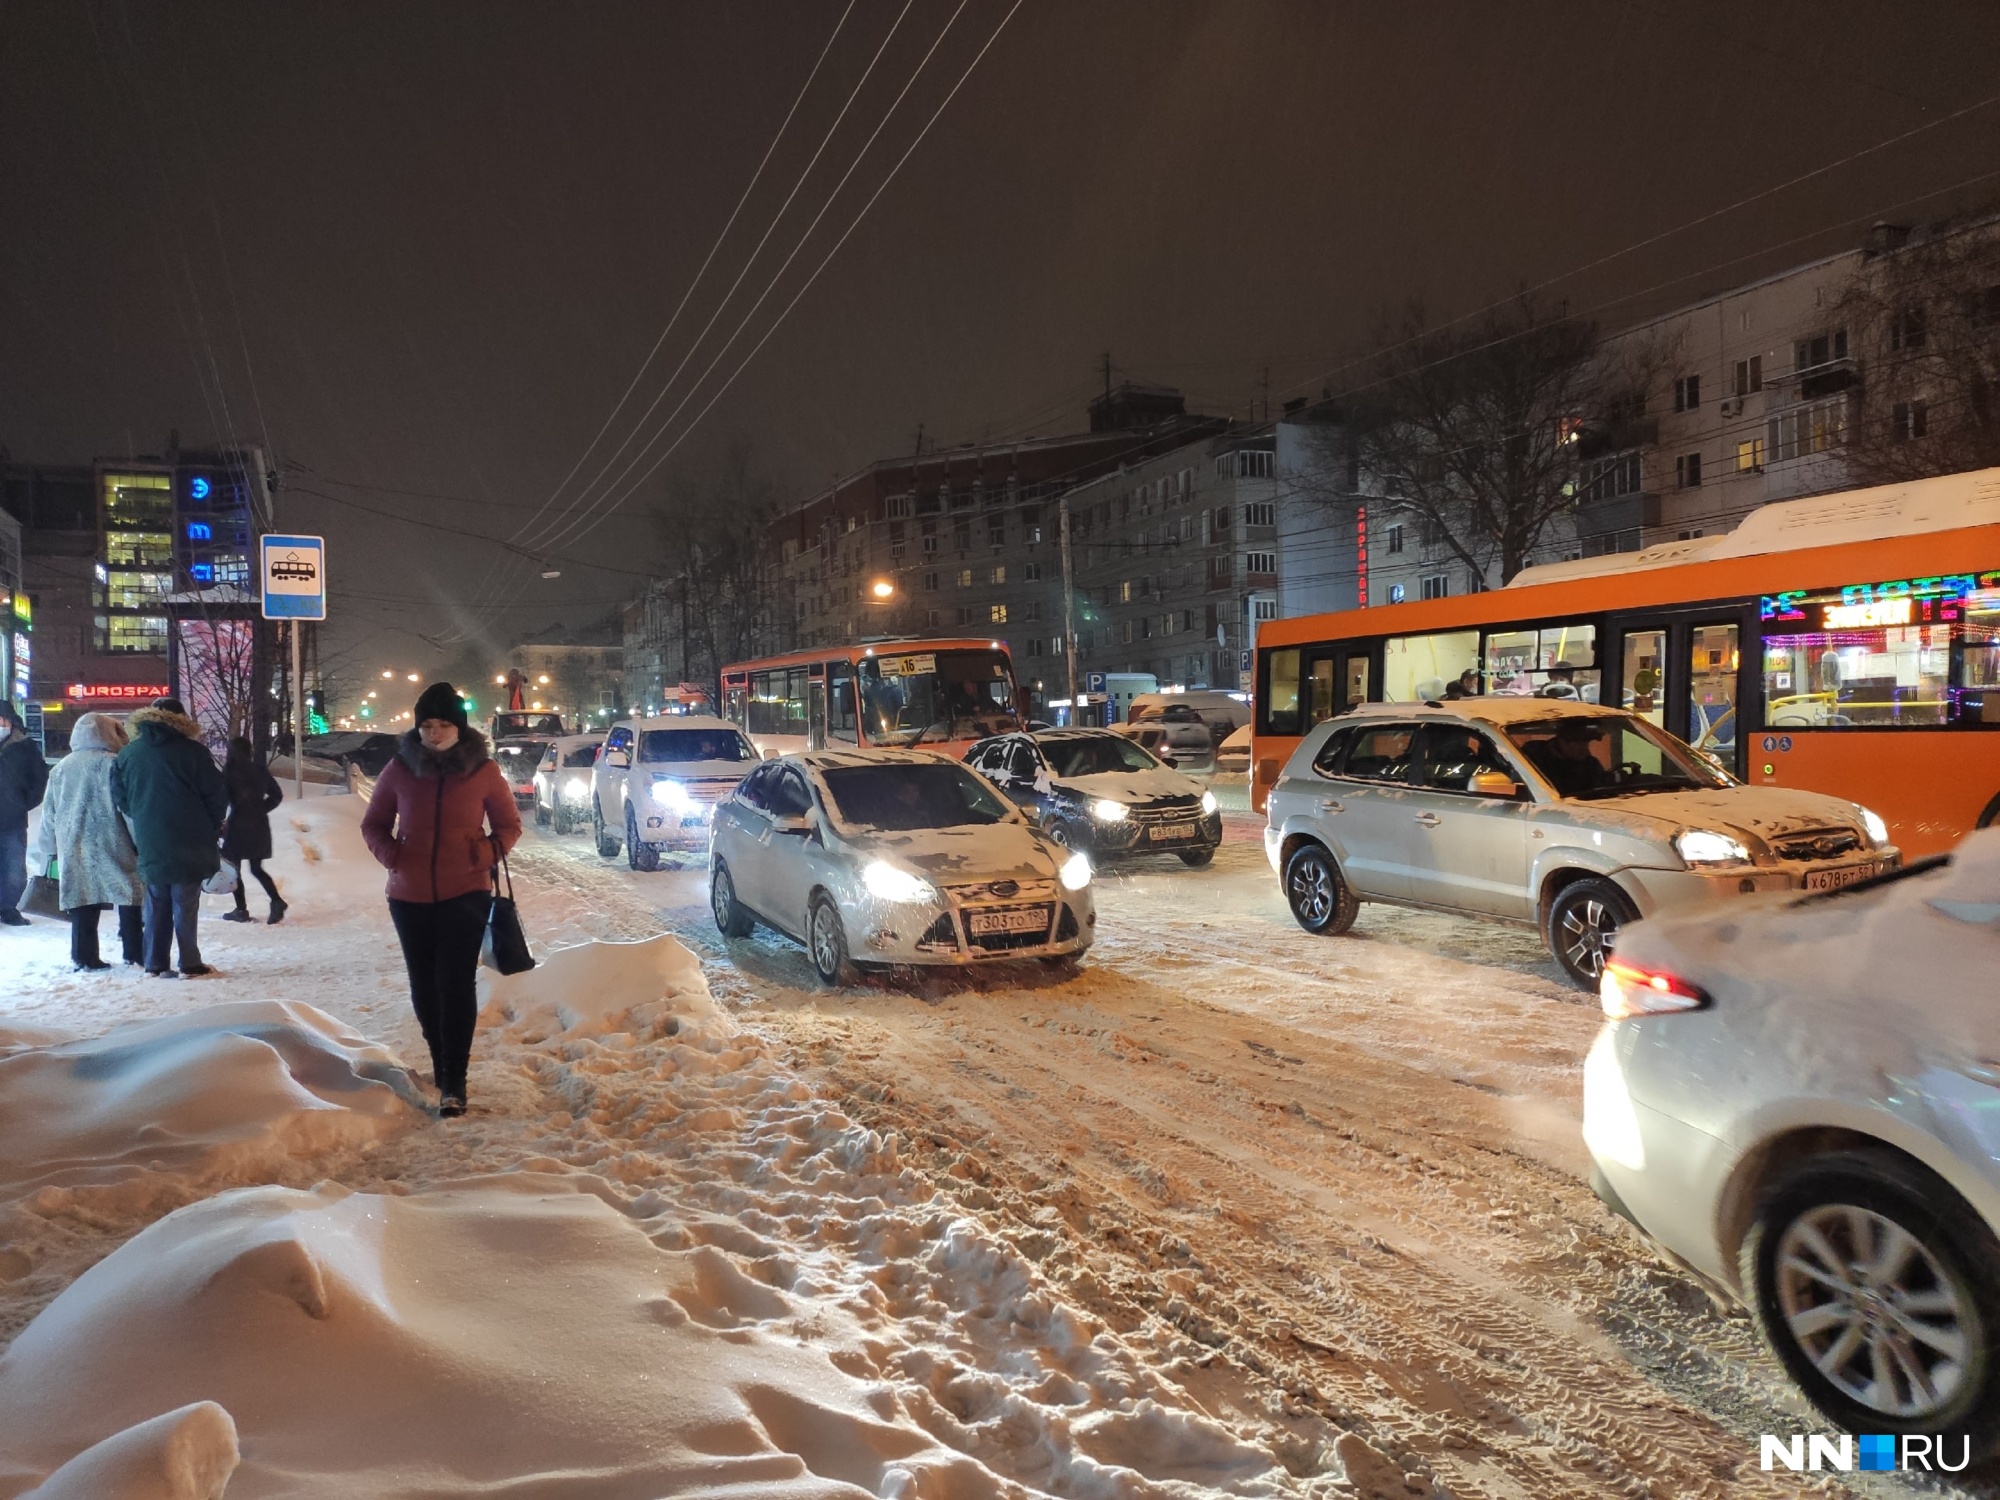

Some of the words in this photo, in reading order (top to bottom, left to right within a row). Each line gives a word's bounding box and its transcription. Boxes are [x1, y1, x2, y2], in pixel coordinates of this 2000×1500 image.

[1241, 651, 1249, 669] P
[1090, 674, 1103, 691] P
[1812, 871, 1855, 889] Х678РТ
[1858, 866, 1869, 878] 52
